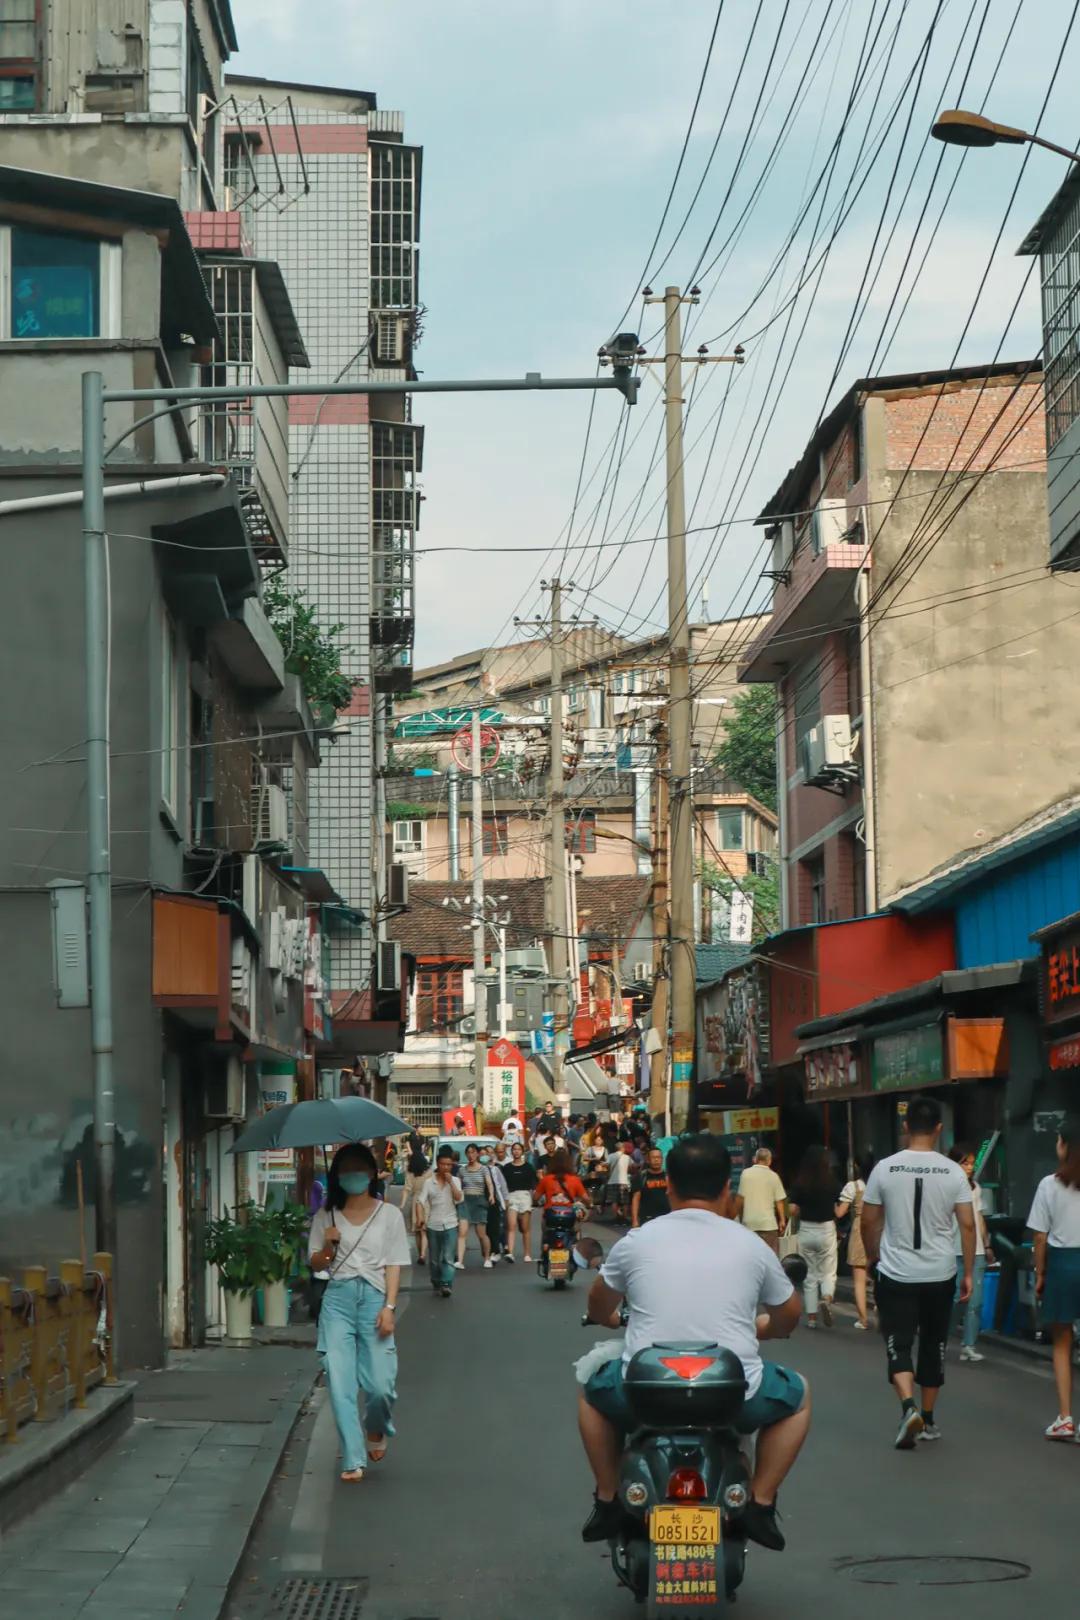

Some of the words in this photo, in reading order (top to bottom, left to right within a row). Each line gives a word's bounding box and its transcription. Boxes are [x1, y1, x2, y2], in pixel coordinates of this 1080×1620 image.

[501, 1070, 513, 1109] 裕南街
[657, 1525, 714, 1541] 0851521
